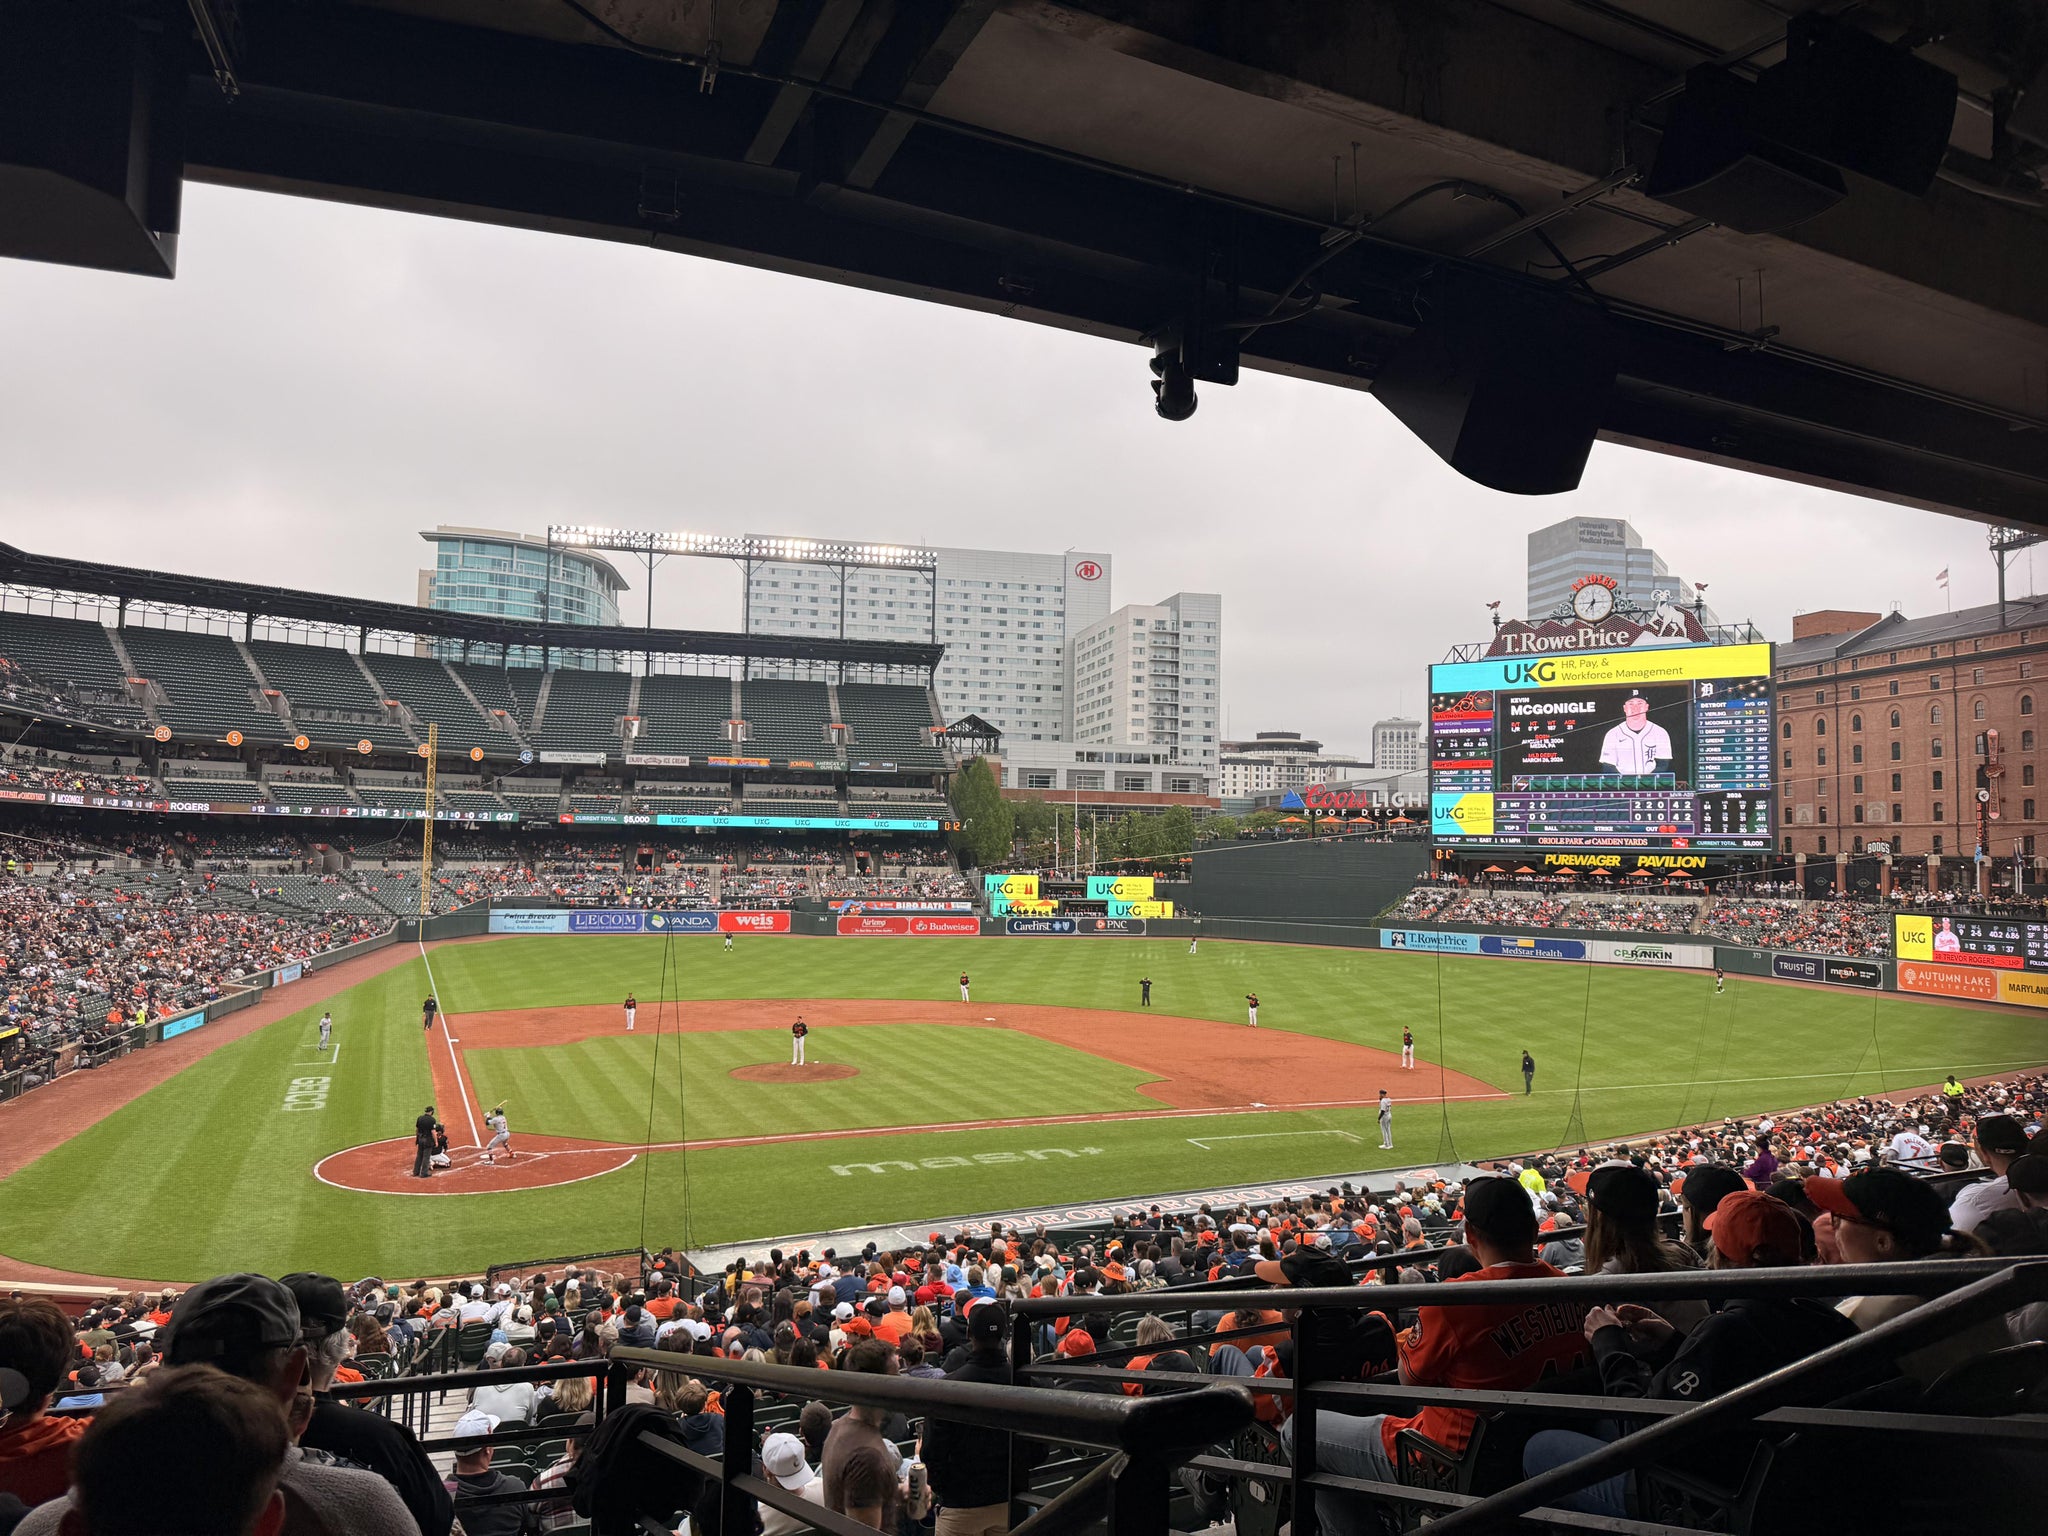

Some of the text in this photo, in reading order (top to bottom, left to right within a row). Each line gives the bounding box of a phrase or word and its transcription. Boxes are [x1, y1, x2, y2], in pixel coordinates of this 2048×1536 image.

[1579, 522, 1608, 530] University
[1579, 536, 1602, 544] Medical
[1562, 658, 1609, 670] HR, Pay, &
[1504, 661, 1556, 684] UKG
[1562, 667, 1683, 682] Workforce Management
[1510, 702, 1596, 716] MCGONIGLE
[157, 730, 169, 738] 20
[231, 734, 238, 743] 5
[360, 742, 370, 751] 22
[522, 753, 532, 761] 42
[1305, 784, 1428, 808] Coors LIGH
[57, 794, 84, 804] MCGONIGLE
[170, 802, 210, 811] ROGERS
[1434, 807, 1464, 820] UKG
[1544, 854, 1706, 868] PUREWAGER PAVILION
[986, 883, 1014, 894] UKG
[1096, 883, 1124, 895] UKG
[1116, 905, 1142, 916] UKG
[576, 914, 636, 925] LECOM
[665, 916, 711, 925] VANDA
[735, 914, 774, 925] weis
[1013, 921, 1051, 931] CareFirst
[1902, 931, 1926, 944] UKG
[1989, 931, 2004, 939] 40.2
[2005, 932, 2020, 940] 6.86
[1502, 947, 1563, 958] MedStar Health
[1631, 950, 1672, 960] RANKIN
[1944, 954, 1995, 964] TREVOR ROGERS
[1779, 962, 1805, 972] TRUIST
[1919, 971, 1991, 987] AUTUMN LAKE
[1918, 981, 1991, 994] HEALTHCARE
[281, 1076, 332, 1112] GEICO
[1910, 1145, 1920, 1158] 7
[951, 1184, 1322, 1234] HOME OF THE ORIOLES
